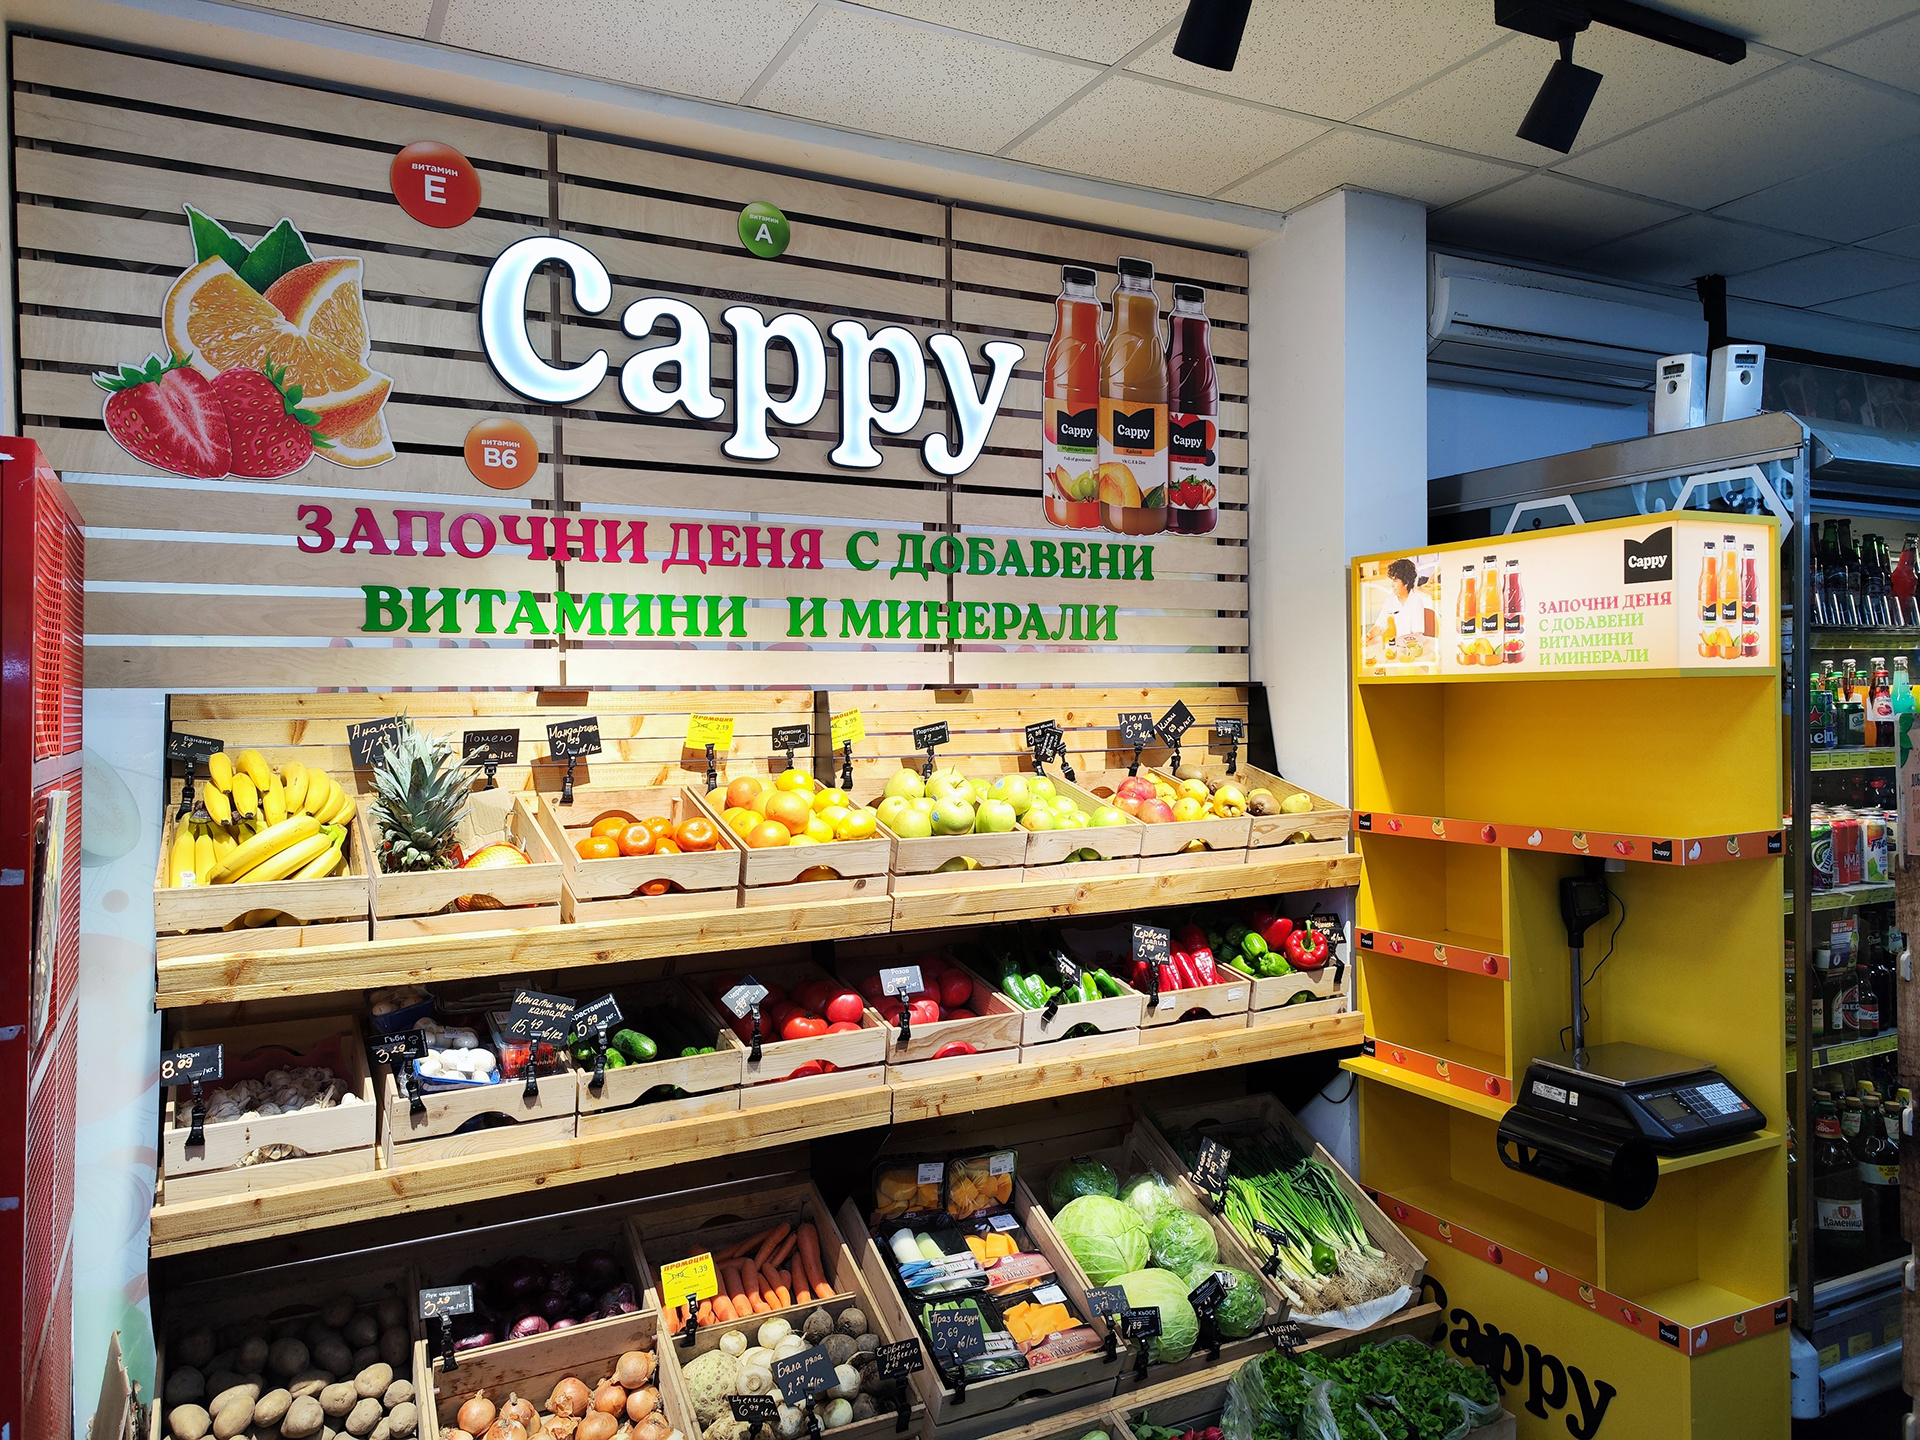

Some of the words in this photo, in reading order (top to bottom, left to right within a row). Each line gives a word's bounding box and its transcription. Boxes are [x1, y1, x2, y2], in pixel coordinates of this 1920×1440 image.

[411, 163, 458, 176] витамин
[424, 174, 447, 204] E
[749, 214, 779, 224] витамин
[754, 223, 774, 244] A
[481, 235, 1025, 476] Cappy
[1060, 423, 1094, 438] Cappy
[1117, 424, 1150, 440] Cappy
[481, 439, 520, 448] витамин
[1173, 434, 1203, 448] Cappy
[484, 447, 518, 469] B6
[297, 504, 646, 563] ЗАПОЧНИ
[661, 522, 822, 574] ДЕНЯ
[845, 530, 880, 571] С
[890, 532, 1155, 581] ДОБАВЕНИ
[1628, 553, 1668, 571] Cappy
[1538, 595, 1619, 614] ЗАПОЧНИ
[1622, 591, 1672, 610] ДЕНЯ
[361, 585, 747, 638] ВИТАМИНИ
[786, 597, 825, 637] И
[839, 598, 1118, 641] МИНЕРАЛИ
[1538, 619, 1549, 632] С
[1551, 612, 1644, 633] ДОБАВЕНИ
[1539, 632, 1634, 649] ВИТАМИНИ
[1539, 653, 1551, 665] И
[1554, 649, 1649, 665] МИНЕРАЛИ
[183, 736, 212, 745] Банани
[464, 732, 513, 744] Помело
[384, 1034, 405, 1043] Гъби
[162, 1058, 193, 1079] 8.09
[664, 1254, 709, 1271] ПРОМОЦИЯ
[694, 1264, 708, 1274] 1.39
